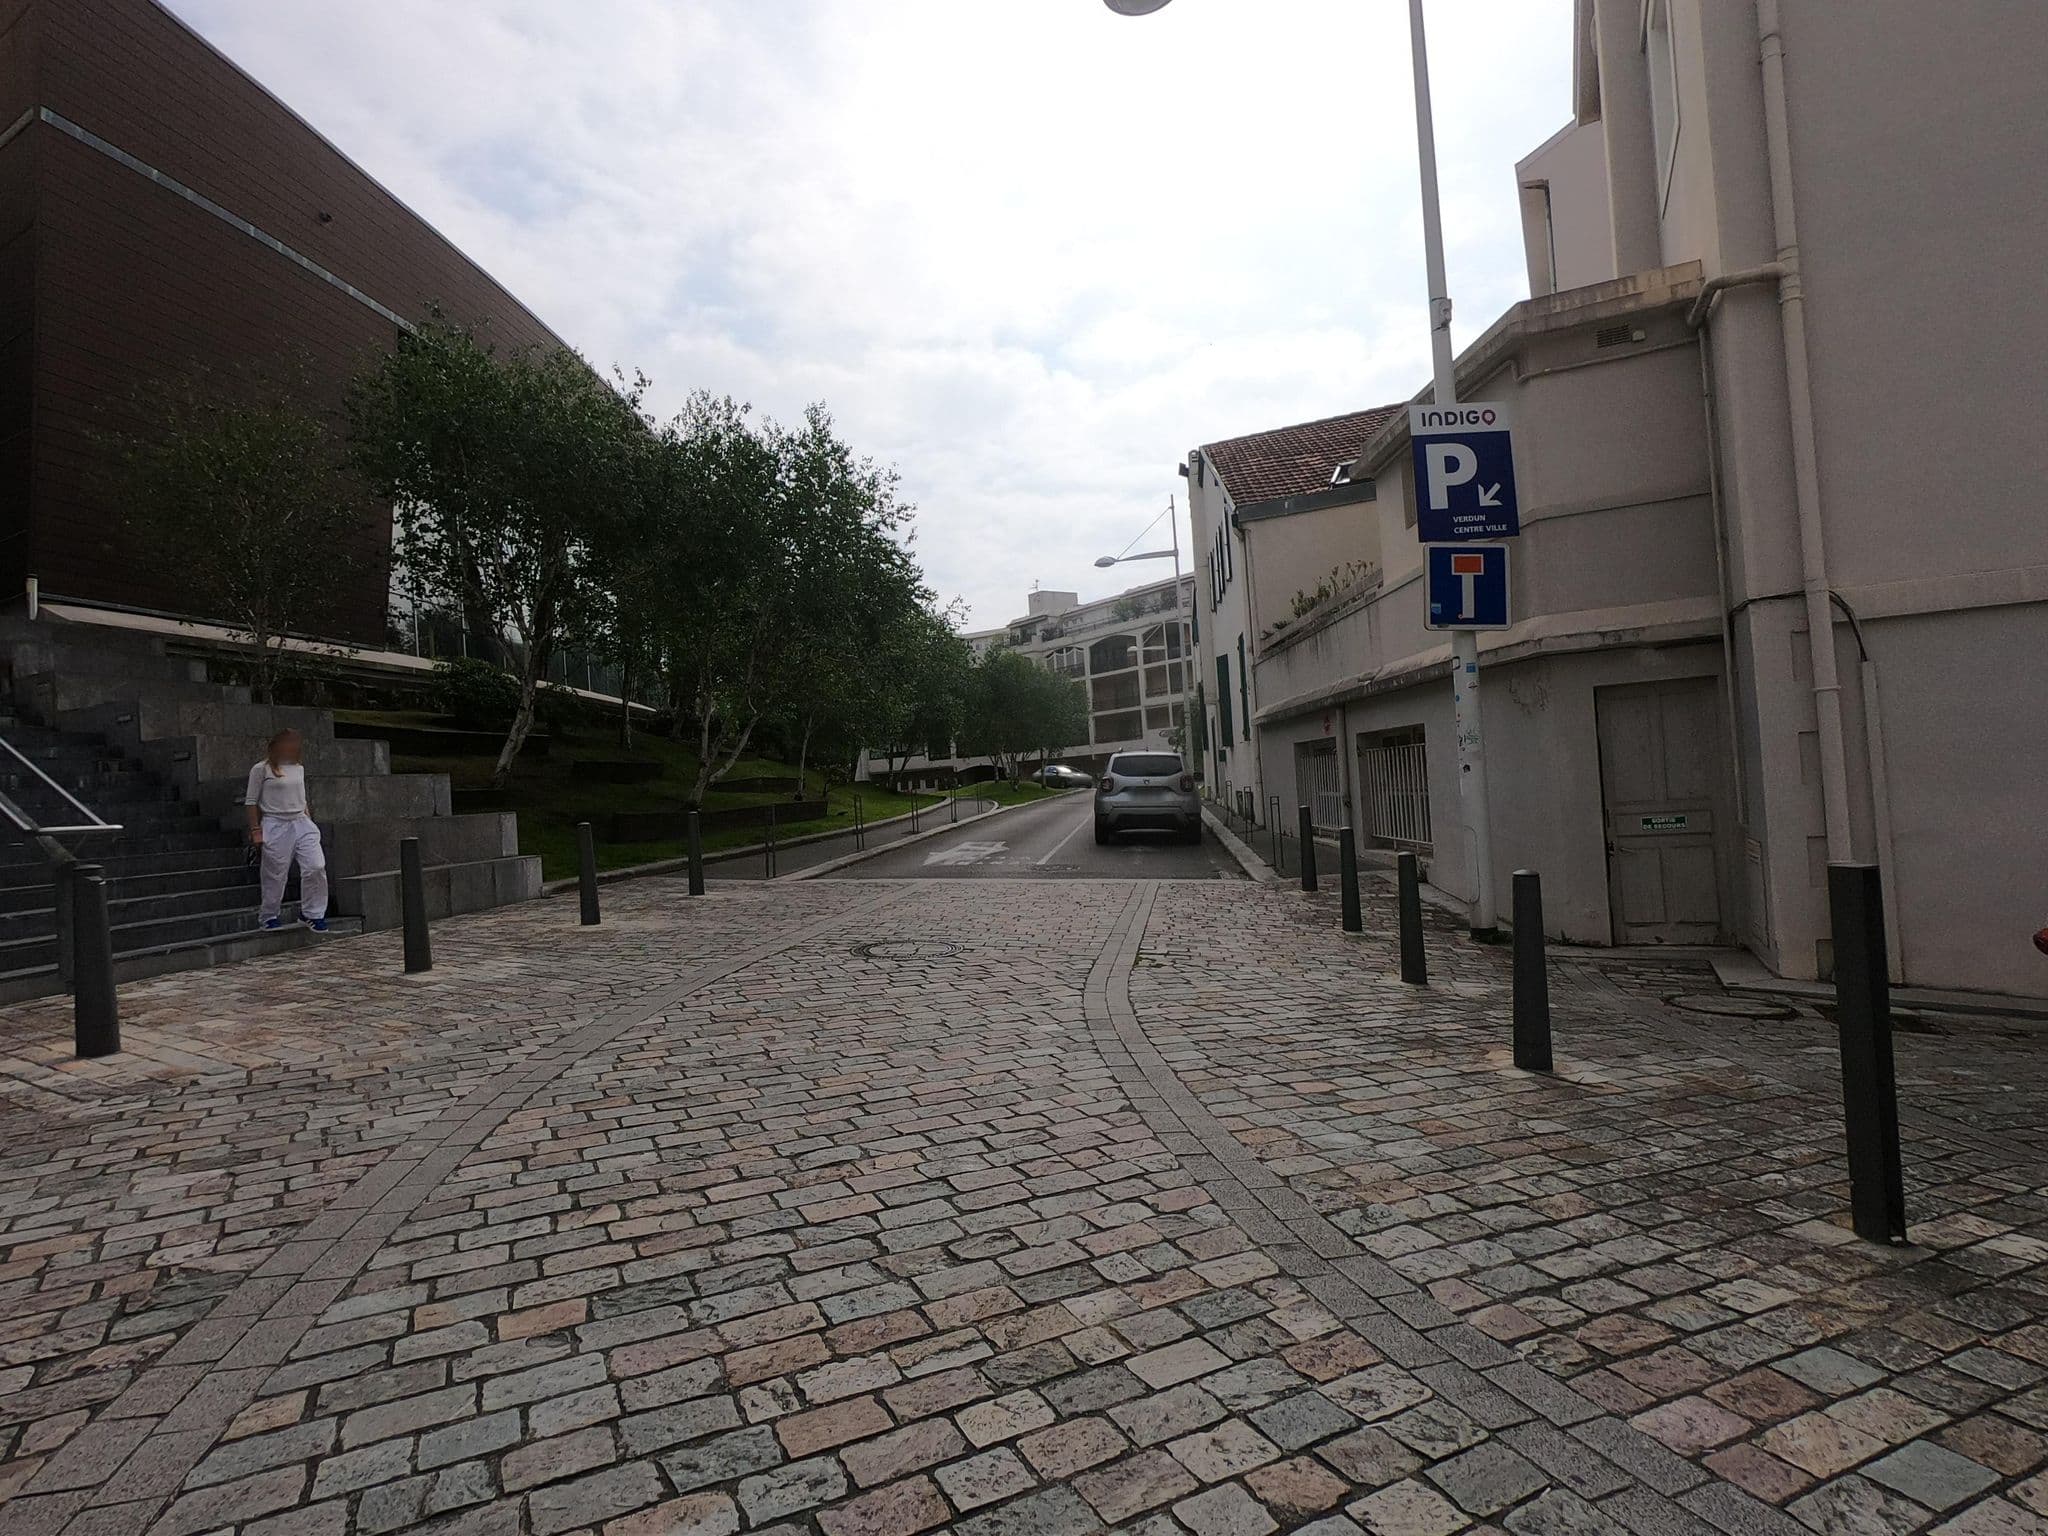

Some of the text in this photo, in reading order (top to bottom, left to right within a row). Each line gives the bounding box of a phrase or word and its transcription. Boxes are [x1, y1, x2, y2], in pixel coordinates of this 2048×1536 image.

[1425, 442, 1478, 510] P
[1453, 514, 1486, 523] VERDUN
[1453, 524, 1508, 534] CENTRE VILLE
